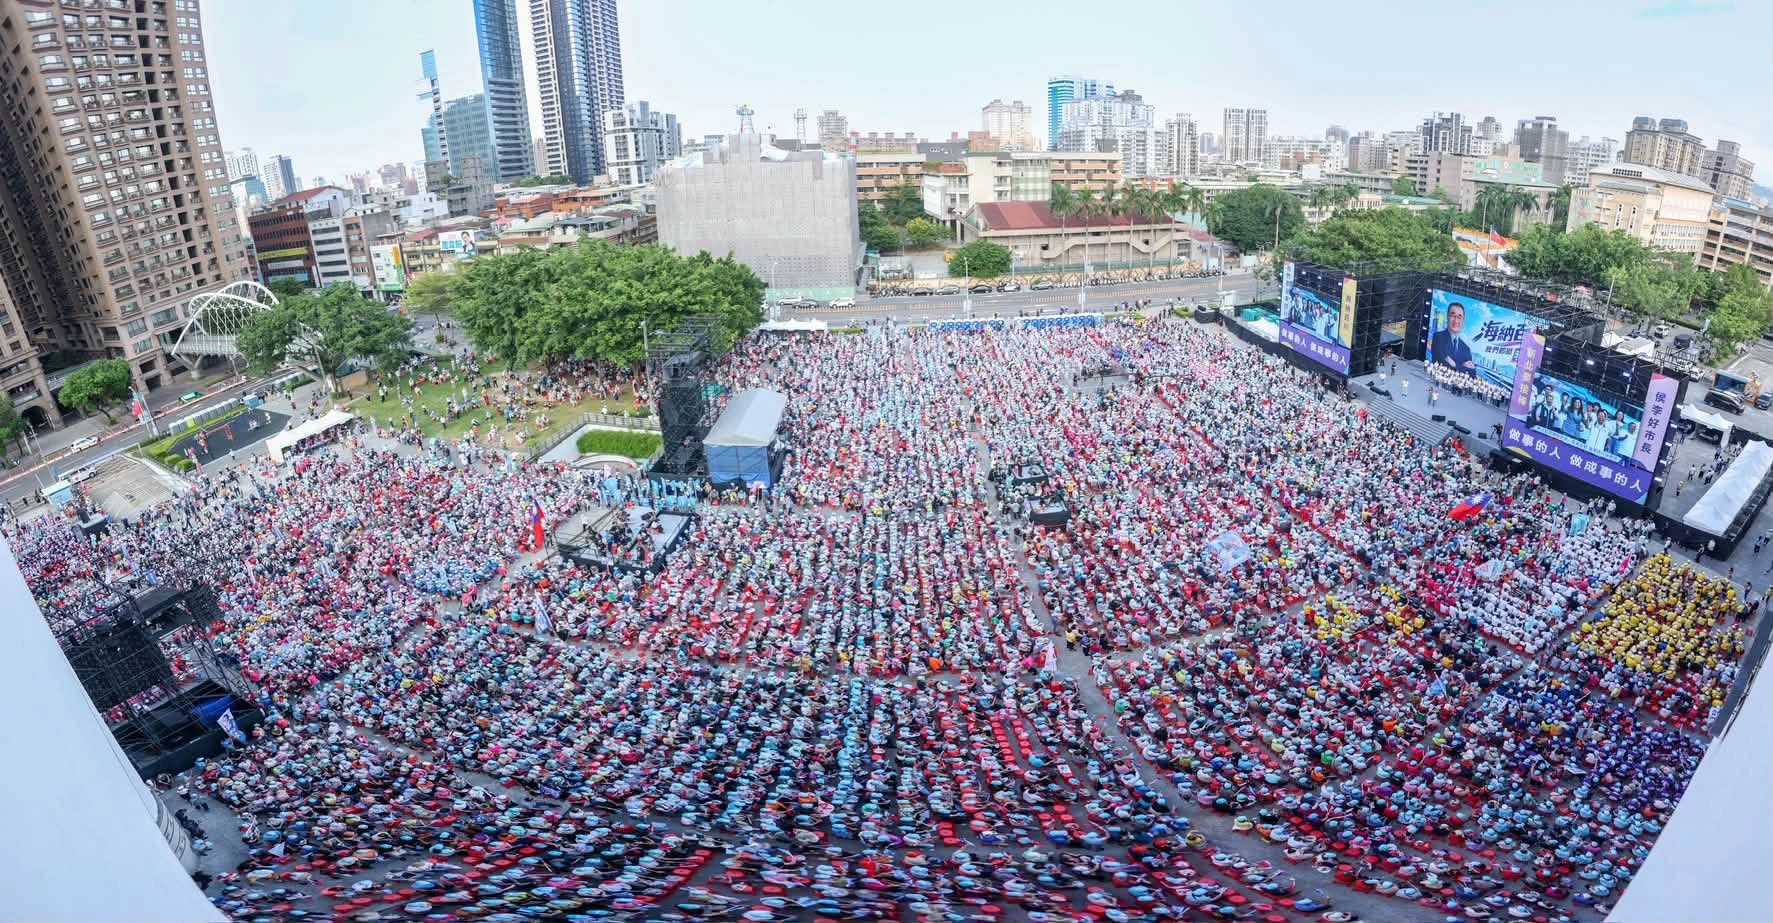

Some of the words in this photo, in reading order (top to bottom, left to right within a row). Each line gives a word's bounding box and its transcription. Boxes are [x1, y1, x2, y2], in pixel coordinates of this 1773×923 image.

[1640, 391, 1666, 455] 侯李好市長
[1509, 428, 1560, 460] 做事的人
[1569, 454, 1642, 493] 做成事的人
